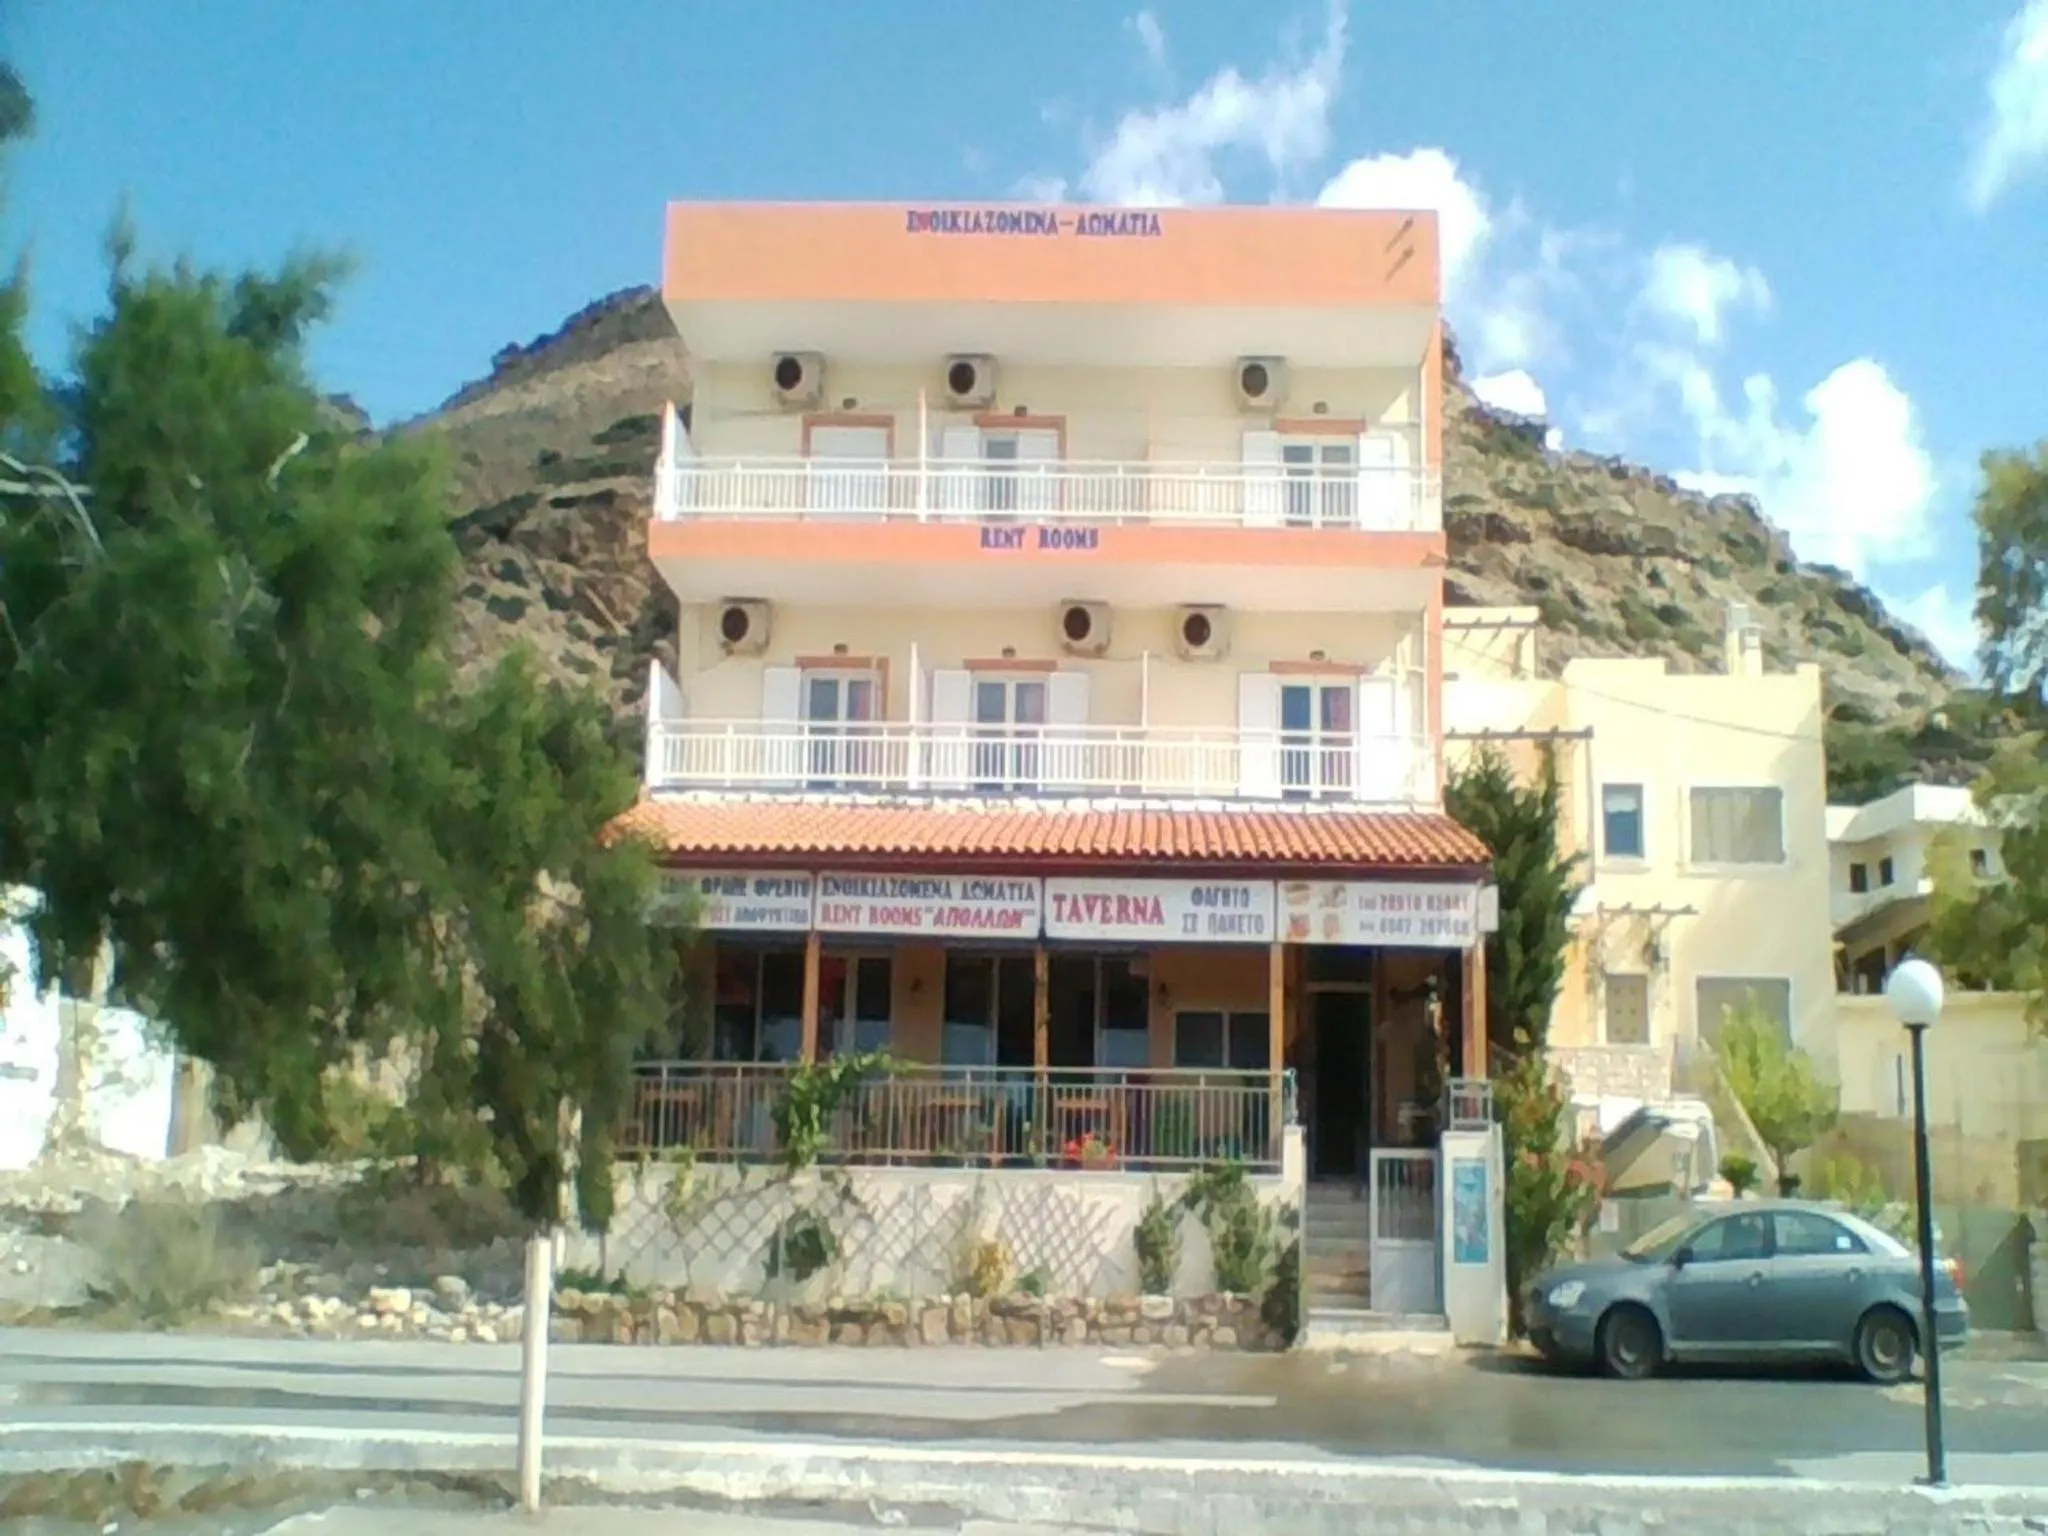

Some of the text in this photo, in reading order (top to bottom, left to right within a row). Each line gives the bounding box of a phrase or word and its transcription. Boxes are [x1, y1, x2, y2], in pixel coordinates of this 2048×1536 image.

[907, 210, 1162, 236] ΕΟΙΚΙΑΖΟΜΕΝΑ-ΔΩΜΑΤΙΑ
[981, 527, 1098, 549] RENT ROOMS
[822, 877, 1035, 902] ΕΝΟΙΚΙΑΖΟΜΕΝΑ ΔΩΜΑΤΙΑ
[821, 903, 862, 925] RENT
[869, 904, 923, 926] ROOMS
[1052, 892, 1165, 925] TAVERNA
